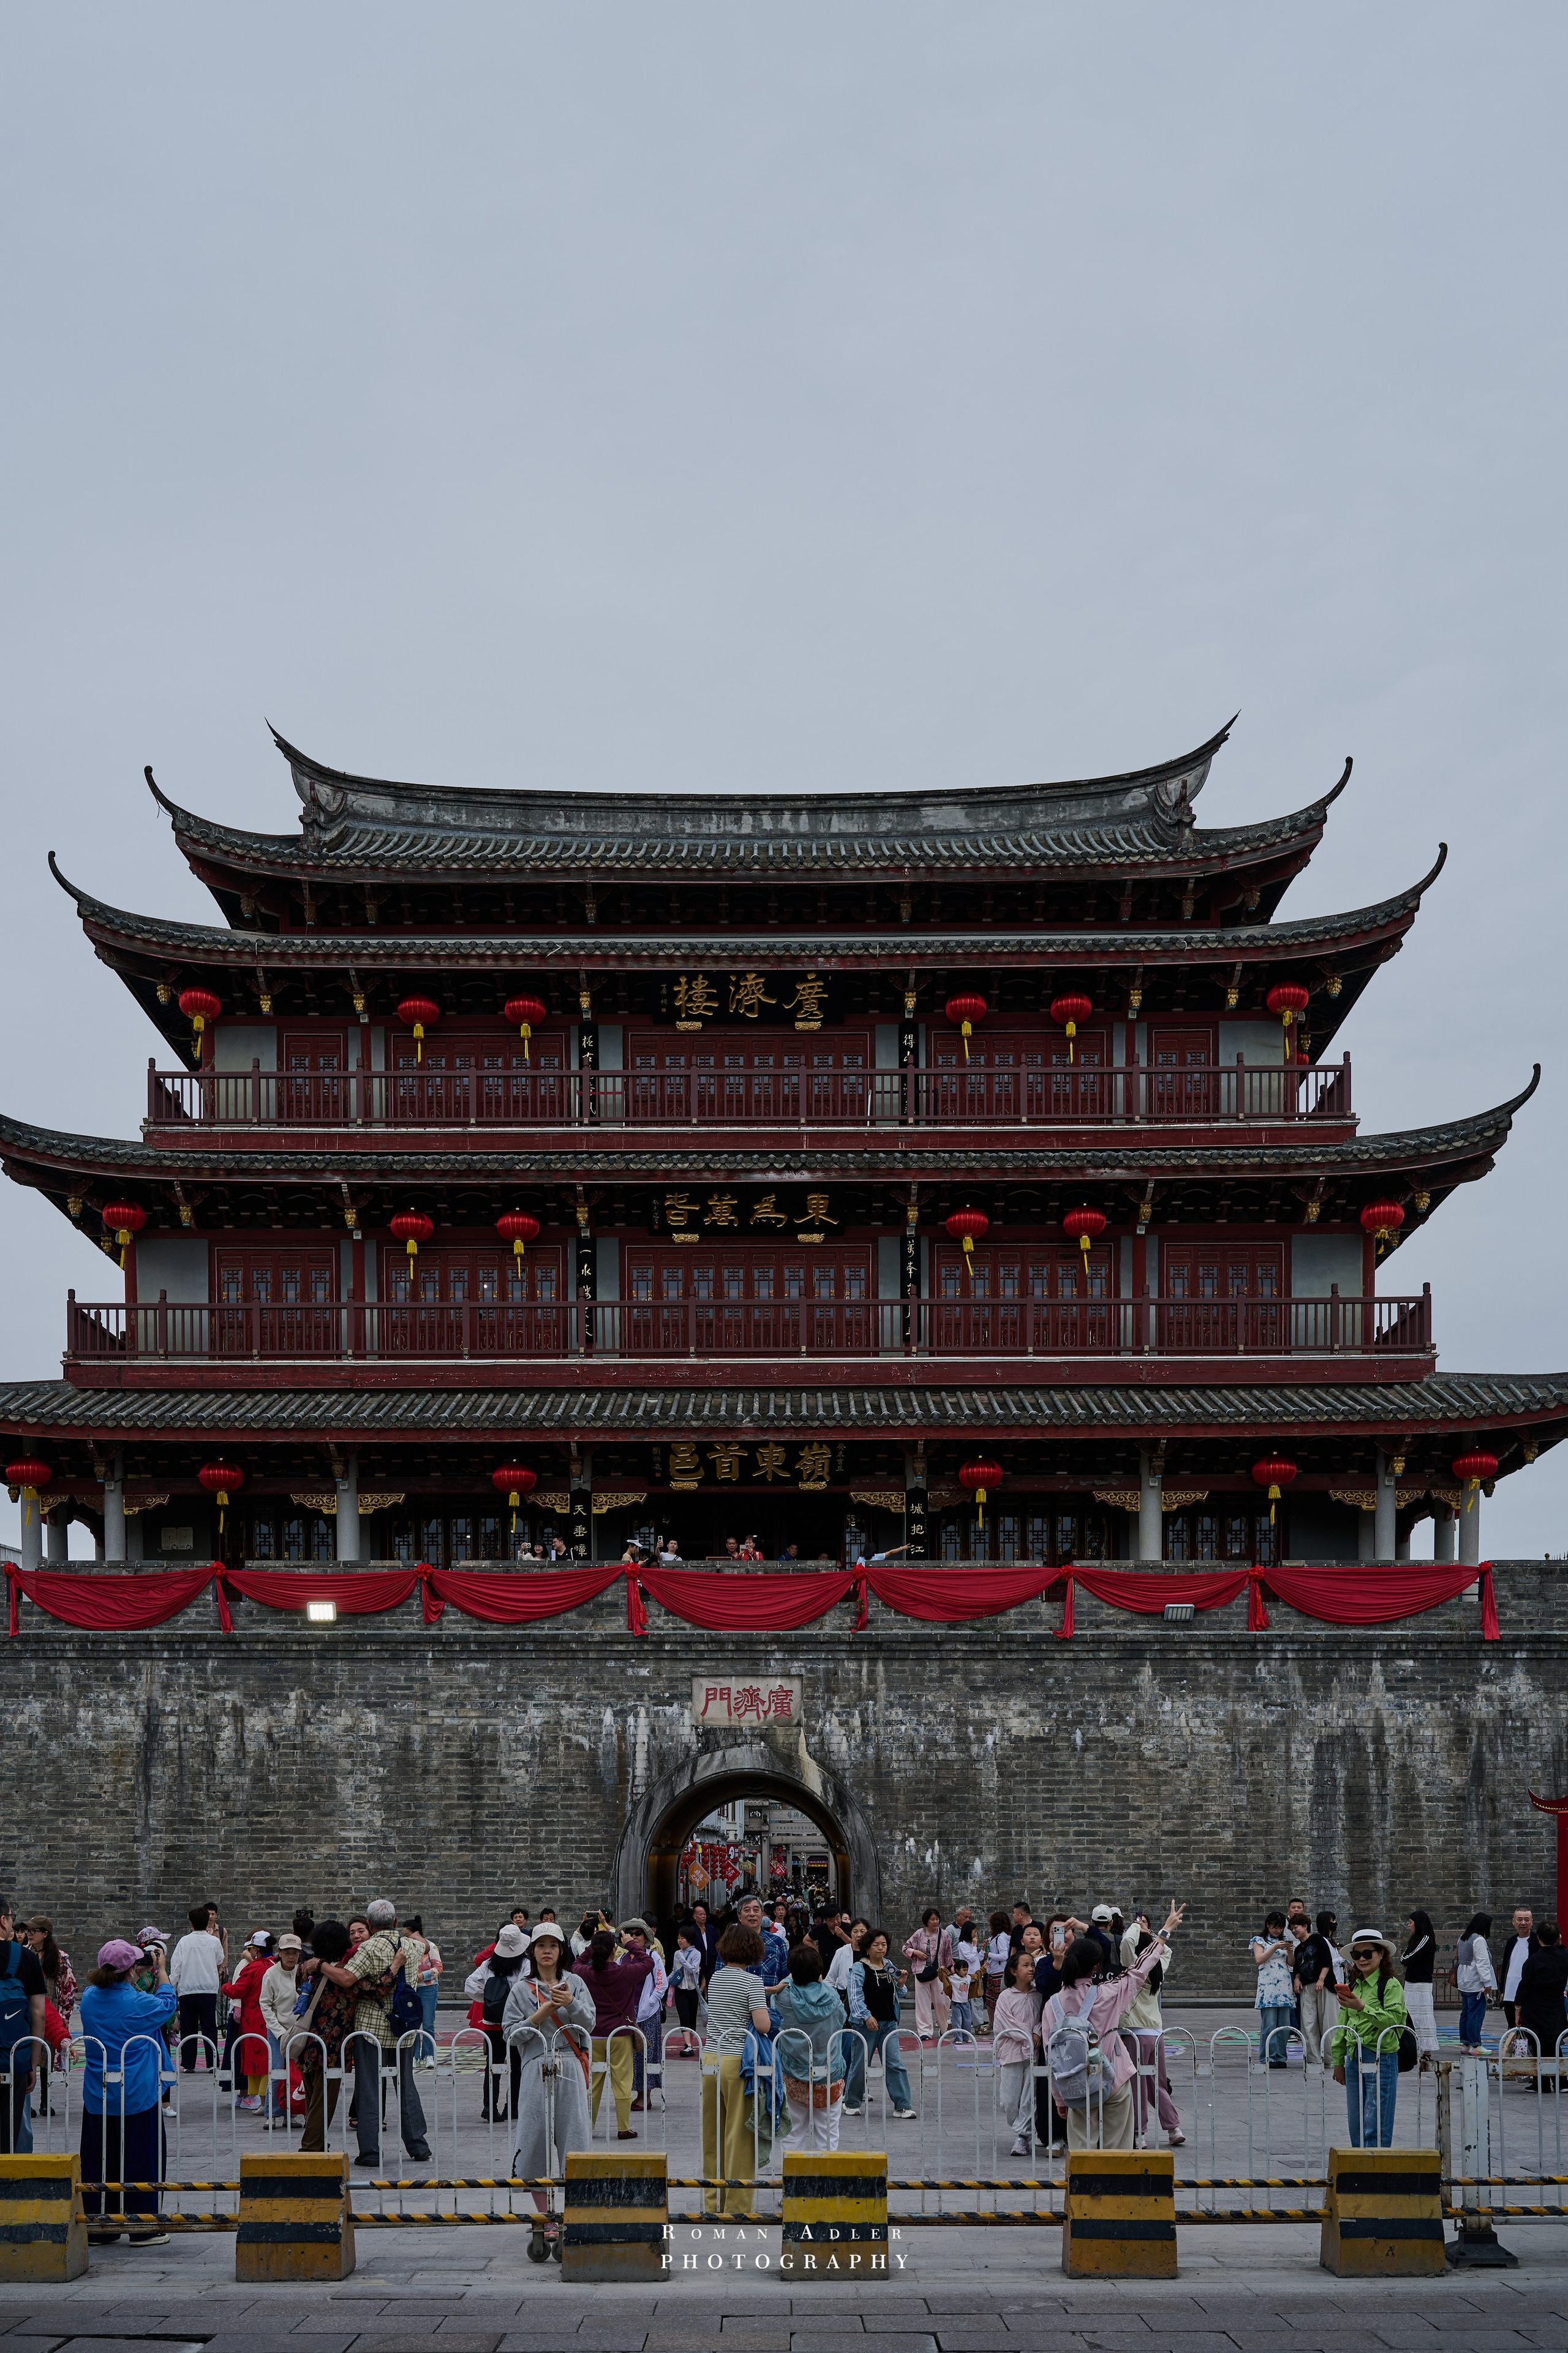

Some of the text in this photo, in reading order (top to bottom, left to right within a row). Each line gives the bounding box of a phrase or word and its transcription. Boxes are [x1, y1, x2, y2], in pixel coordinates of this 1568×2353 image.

[673, 972, 829, 1019] 廣濟樓
[668, 1441, 832, 1481] 嶺東首邑
[700, 1685, 793, 1721] 廣濟門
